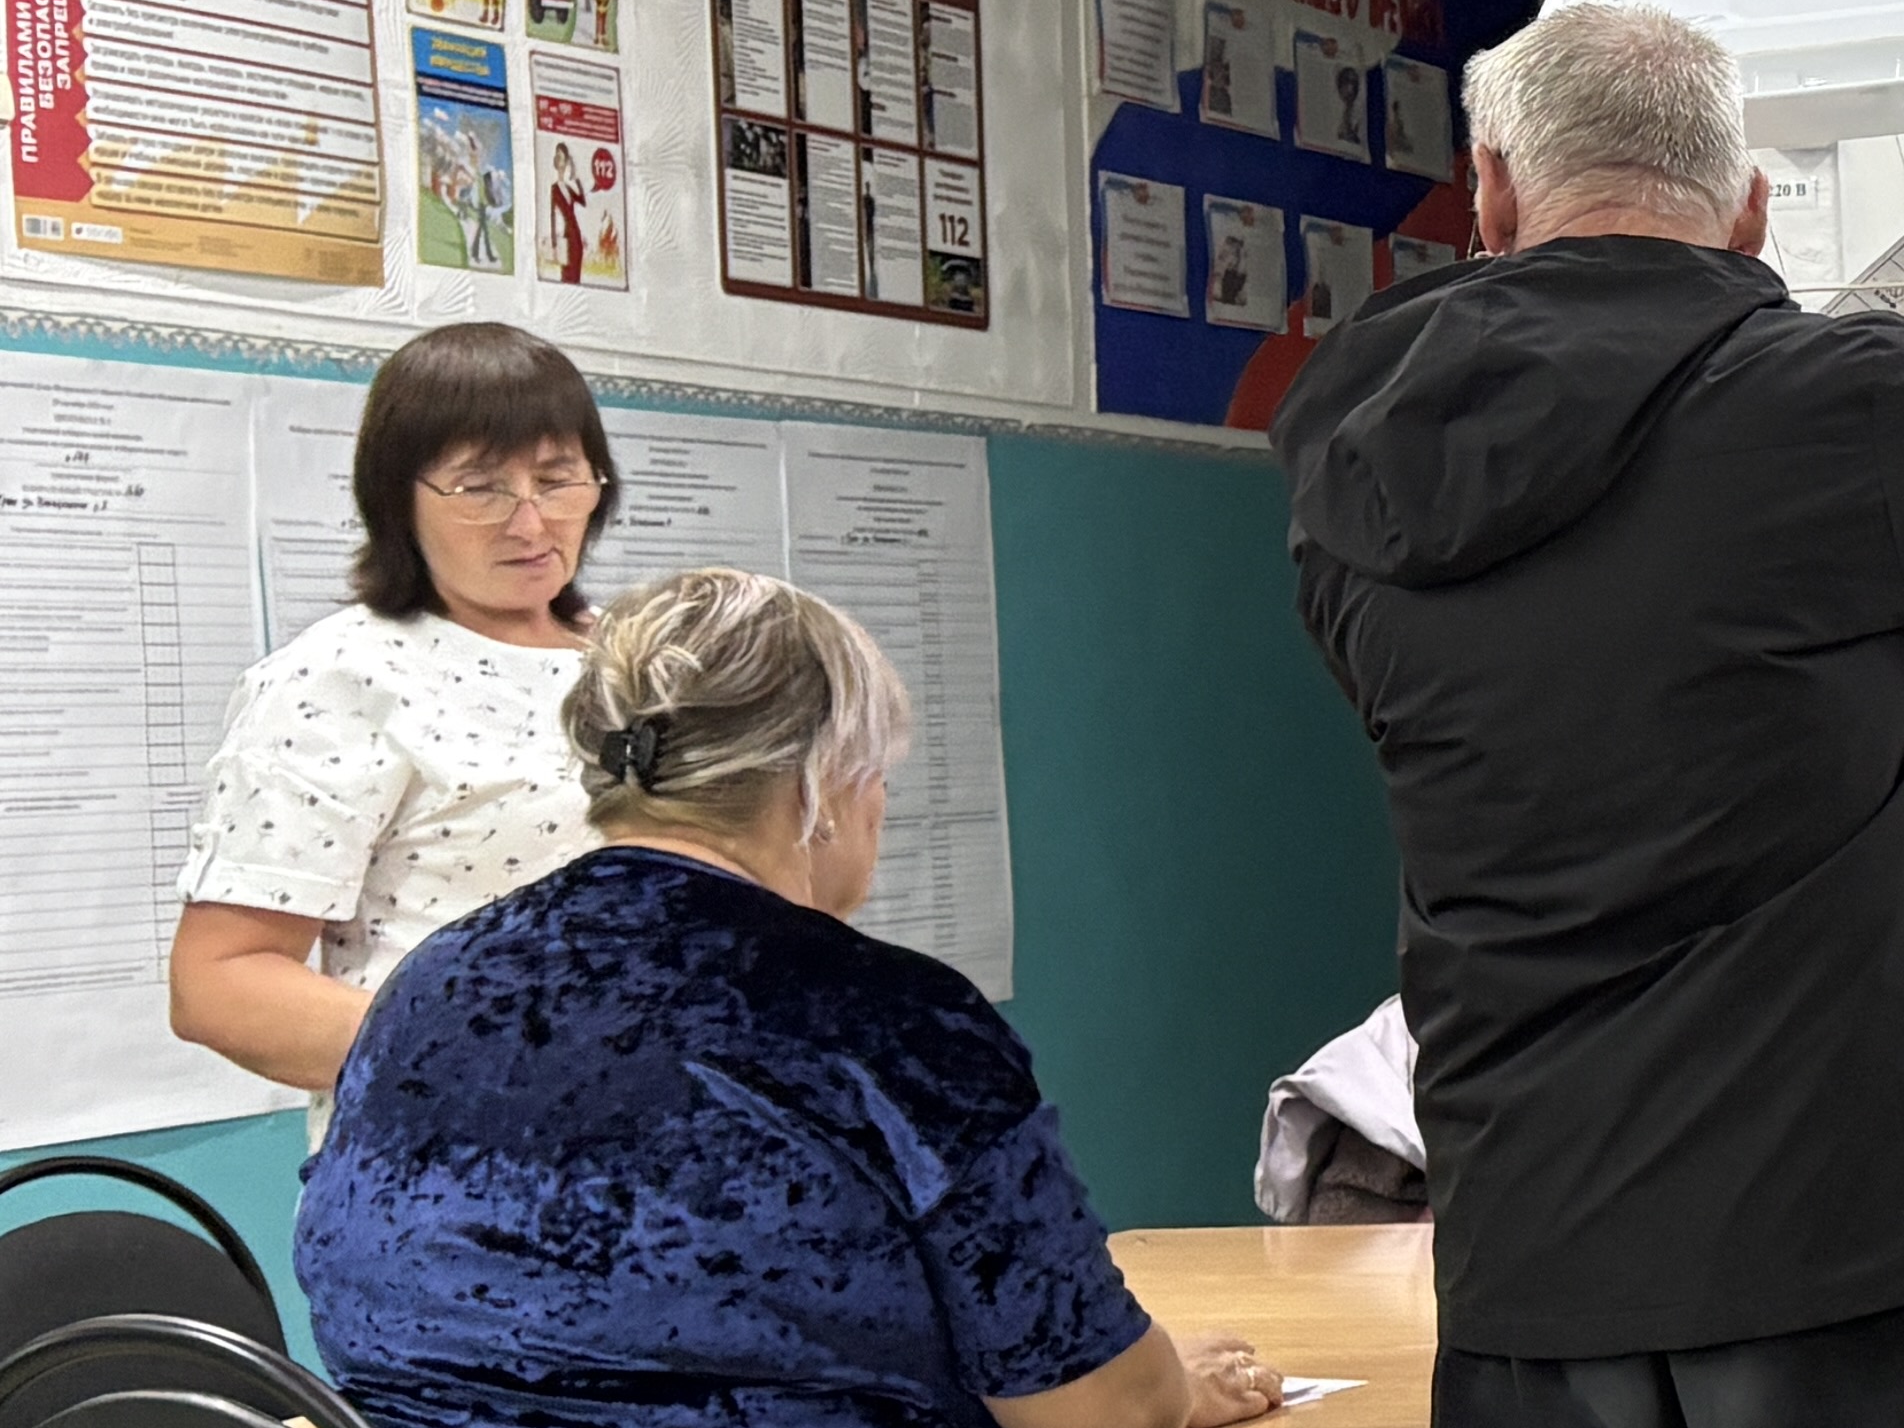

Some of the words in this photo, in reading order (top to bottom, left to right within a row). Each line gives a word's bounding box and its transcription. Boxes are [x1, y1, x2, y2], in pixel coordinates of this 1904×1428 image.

[19, 0, 40, 163] ПРАВИЛАМИ
[591, 155, 614, 181] 112
[938, 212, 971, 248] 112
